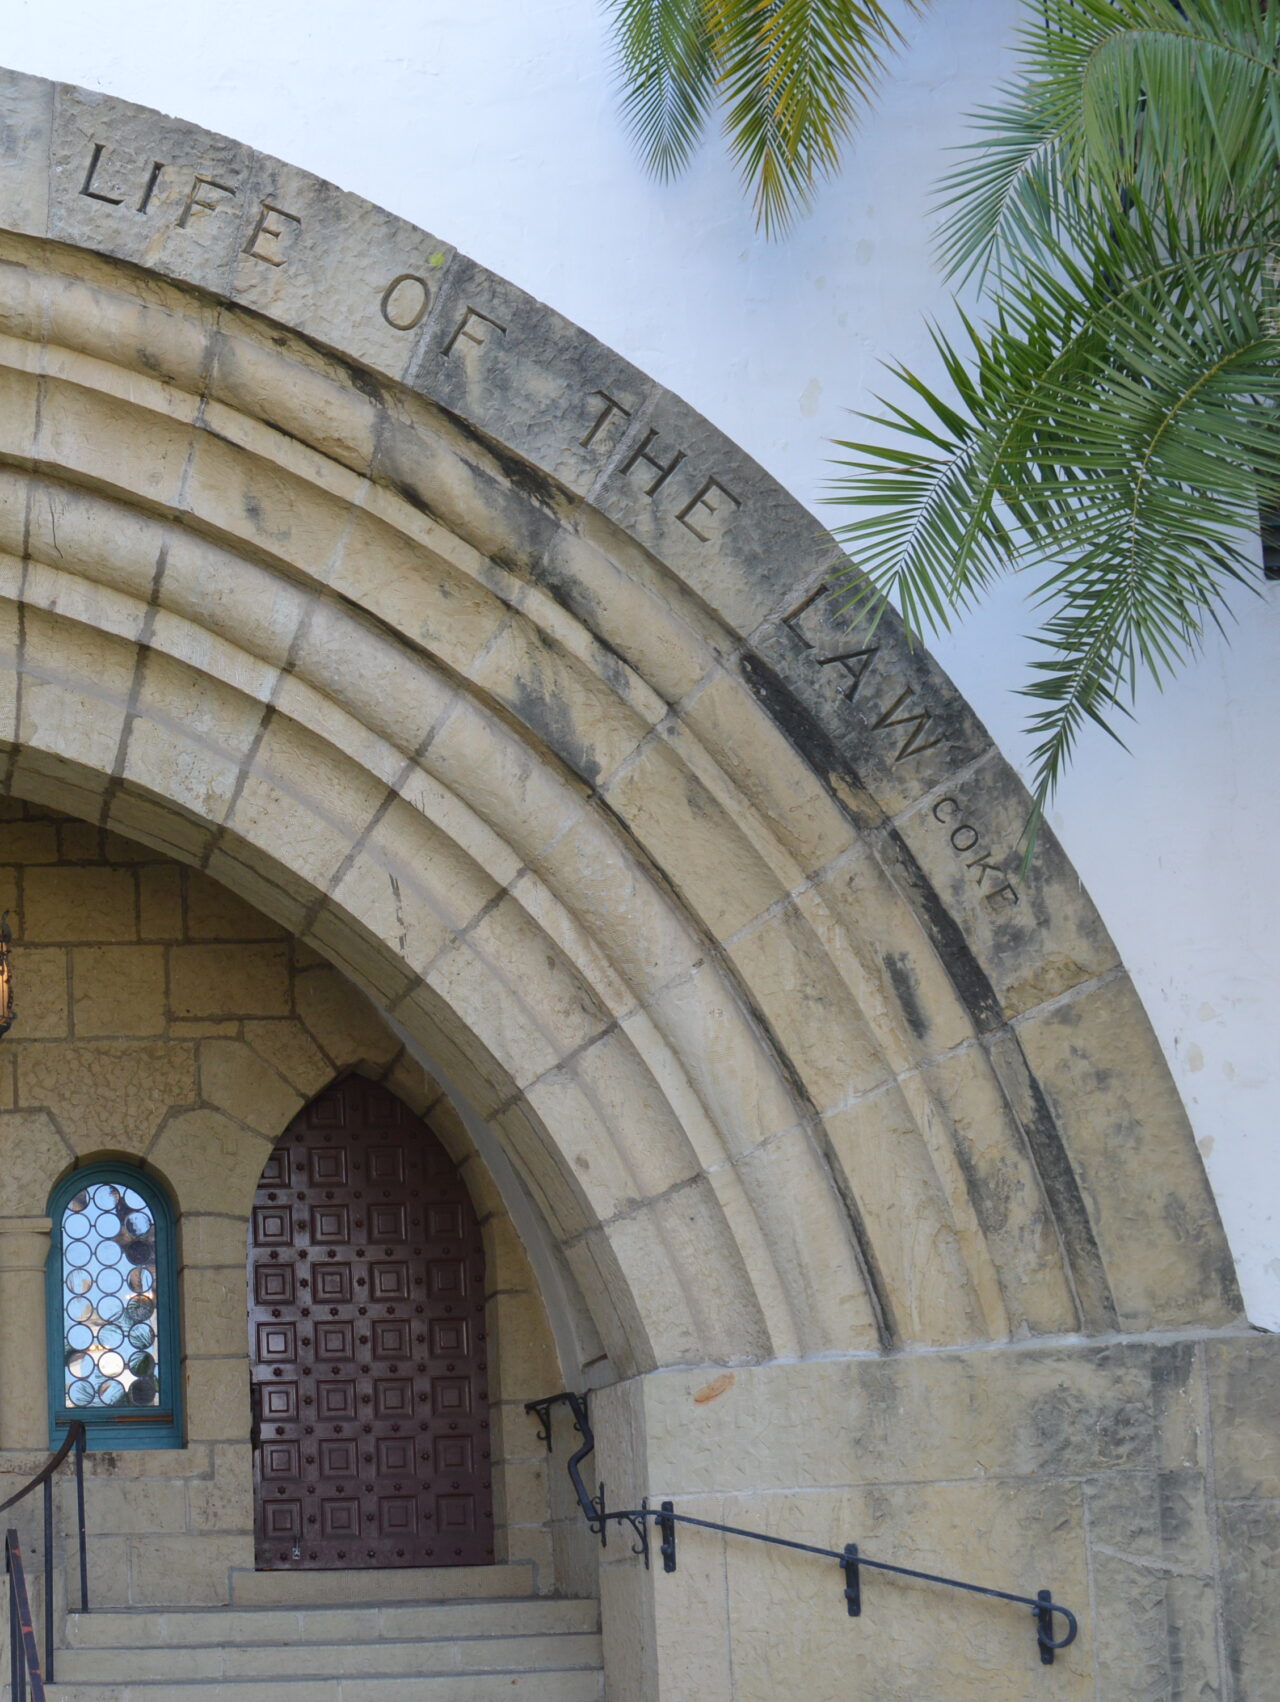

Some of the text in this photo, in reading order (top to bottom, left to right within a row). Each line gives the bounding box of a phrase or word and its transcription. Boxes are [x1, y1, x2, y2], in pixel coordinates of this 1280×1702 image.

[79, 142, 302, 268] LIFE
[380, 273, 508, 358] OF
[577, 389, 742, 543] THE
[781, 583, 947, 763] LAW
[932, 797, 1019, 912] COKE
